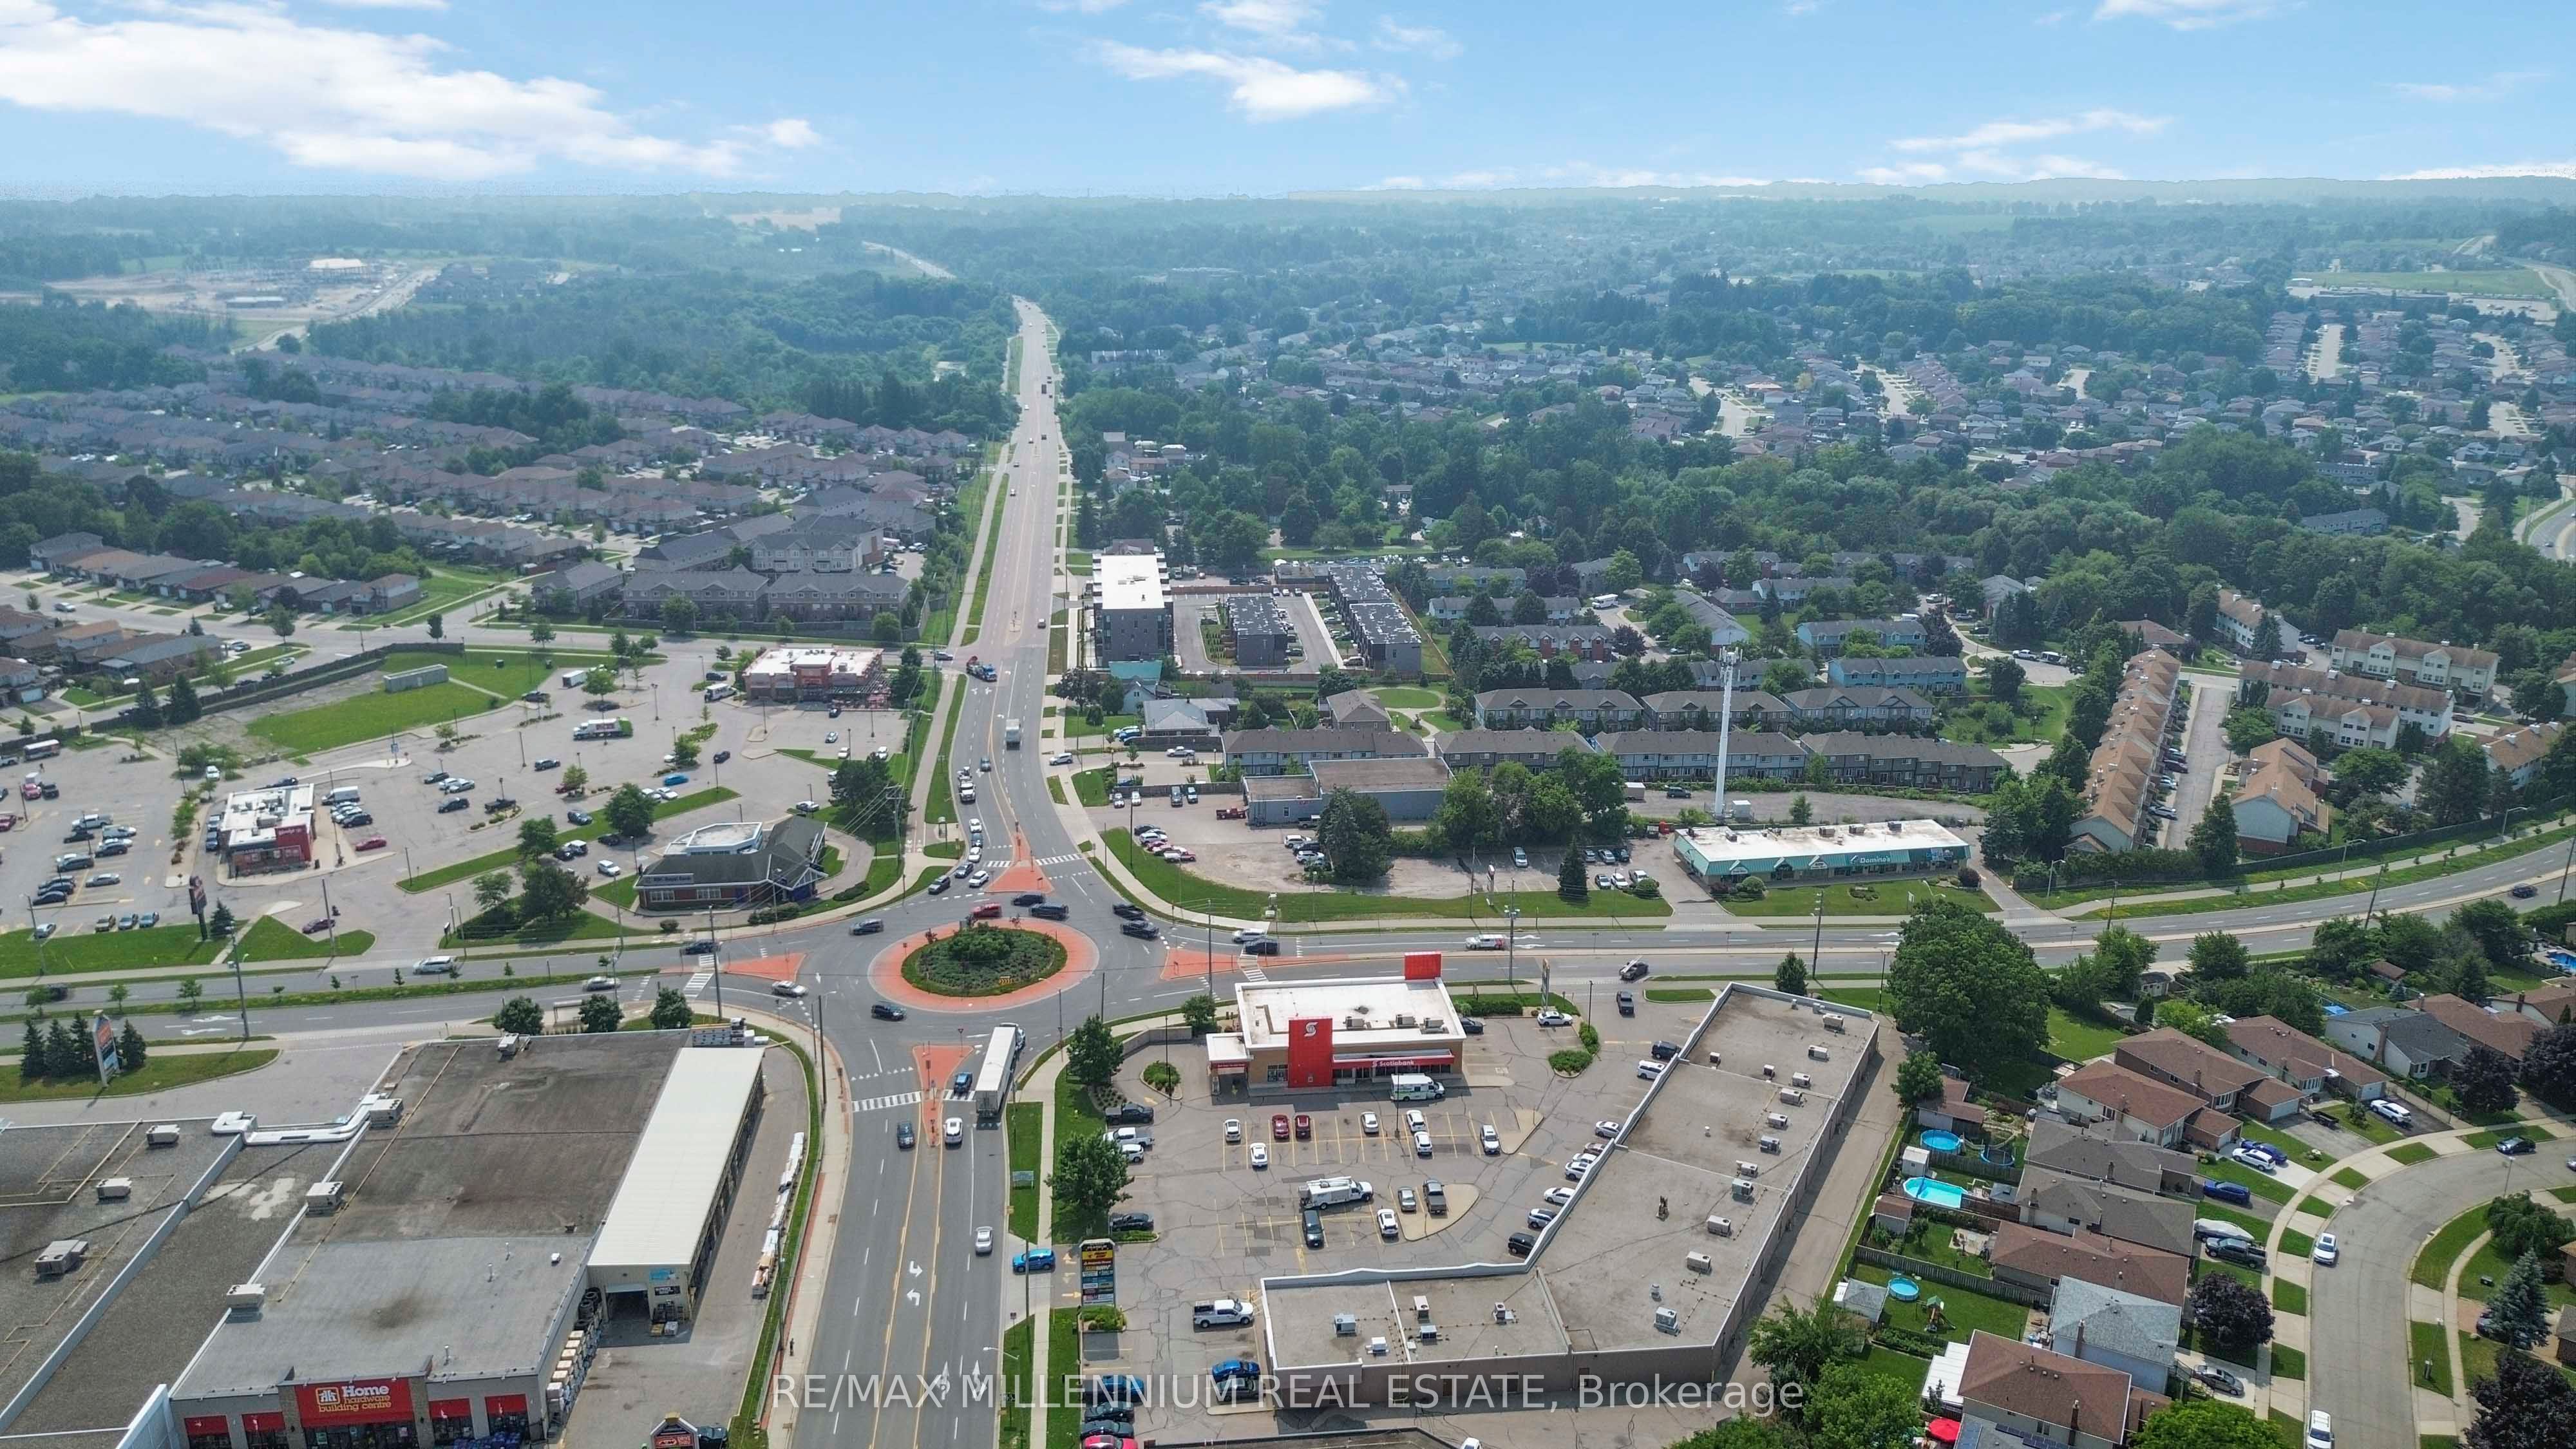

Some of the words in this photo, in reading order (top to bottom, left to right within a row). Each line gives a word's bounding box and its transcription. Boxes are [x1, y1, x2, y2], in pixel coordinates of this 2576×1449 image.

[1860, 855, 1891, 864] Domino's
[342, 1385, 389, 1397] Home
[344, 1394, 390, 1404] hardware
[318, 1403, 359, 1412] building
[361, 1400, 392, 1409] centre
